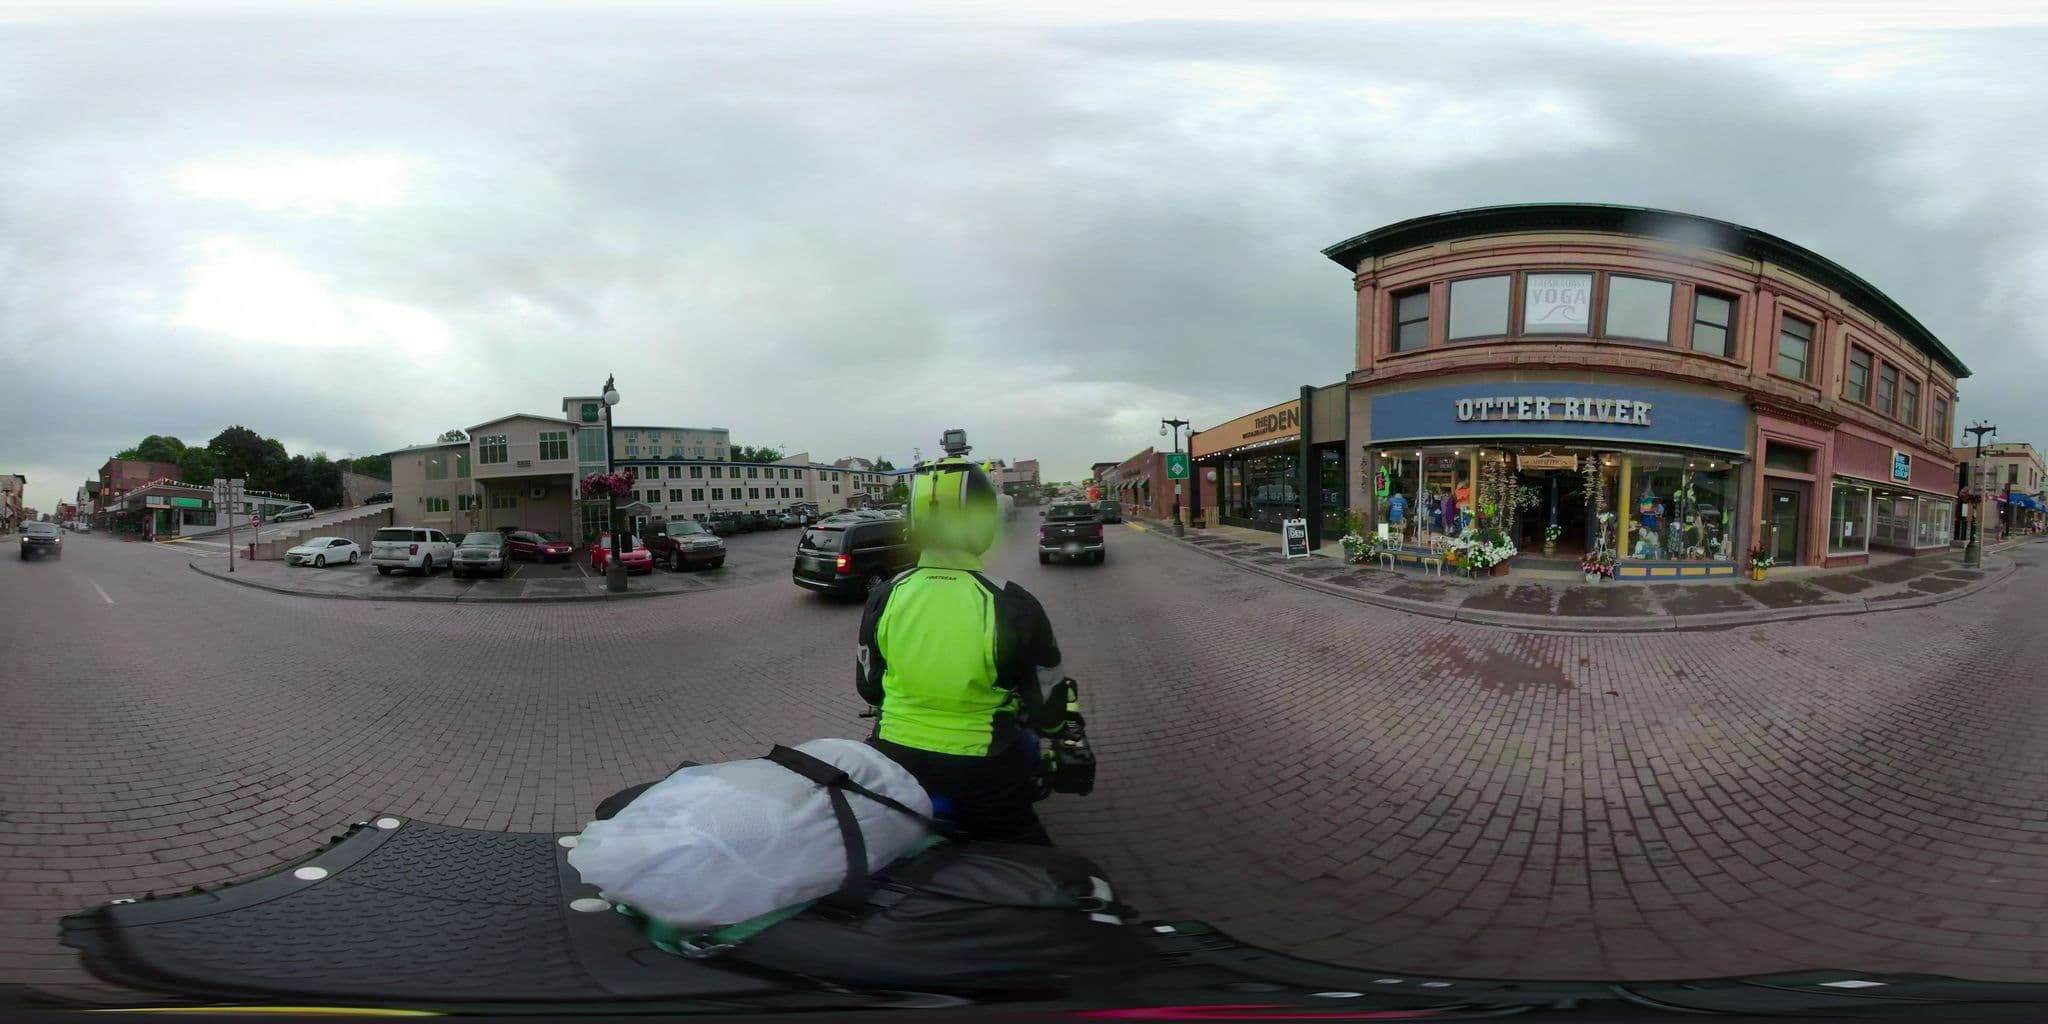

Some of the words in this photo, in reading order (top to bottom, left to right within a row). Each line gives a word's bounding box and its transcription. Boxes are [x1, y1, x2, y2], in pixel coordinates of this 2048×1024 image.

[1532, 288, 1586, 305] YOGA
[1254, 415, 1268, 429] THE
[1268, 406, 1300, 433] DEN
[1457, 396, 1551, 421] OTTER
[1564, 396, 1650, 426] RIVER
